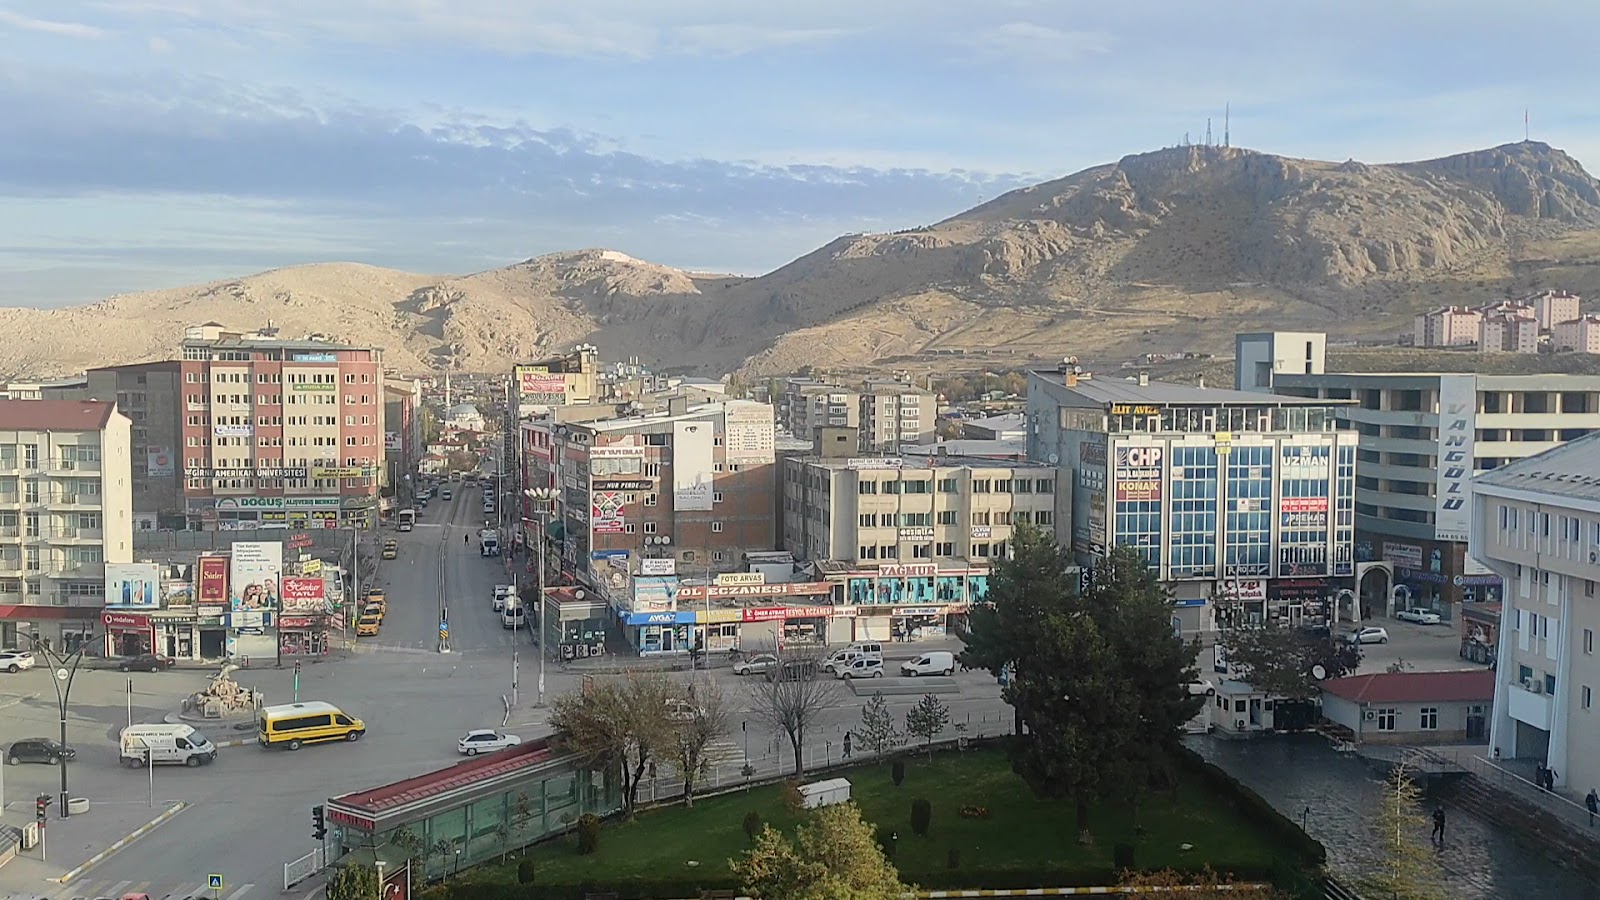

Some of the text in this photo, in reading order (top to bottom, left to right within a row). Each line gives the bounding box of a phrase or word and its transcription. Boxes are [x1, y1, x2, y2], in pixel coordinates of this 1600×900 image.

[1128, 447, 1161, 466] CHP
[1282, 456, 1329, 466] UZMAN
[214, 469, 255, 477] AMERİKAN
[1118, 482, 1159, 491] KONAK
[241, 498, 283, 507] DOĞUŞ
[721, 574, 738, 582] FOTO
[708, 584, 788, 595] ECZANESİ
